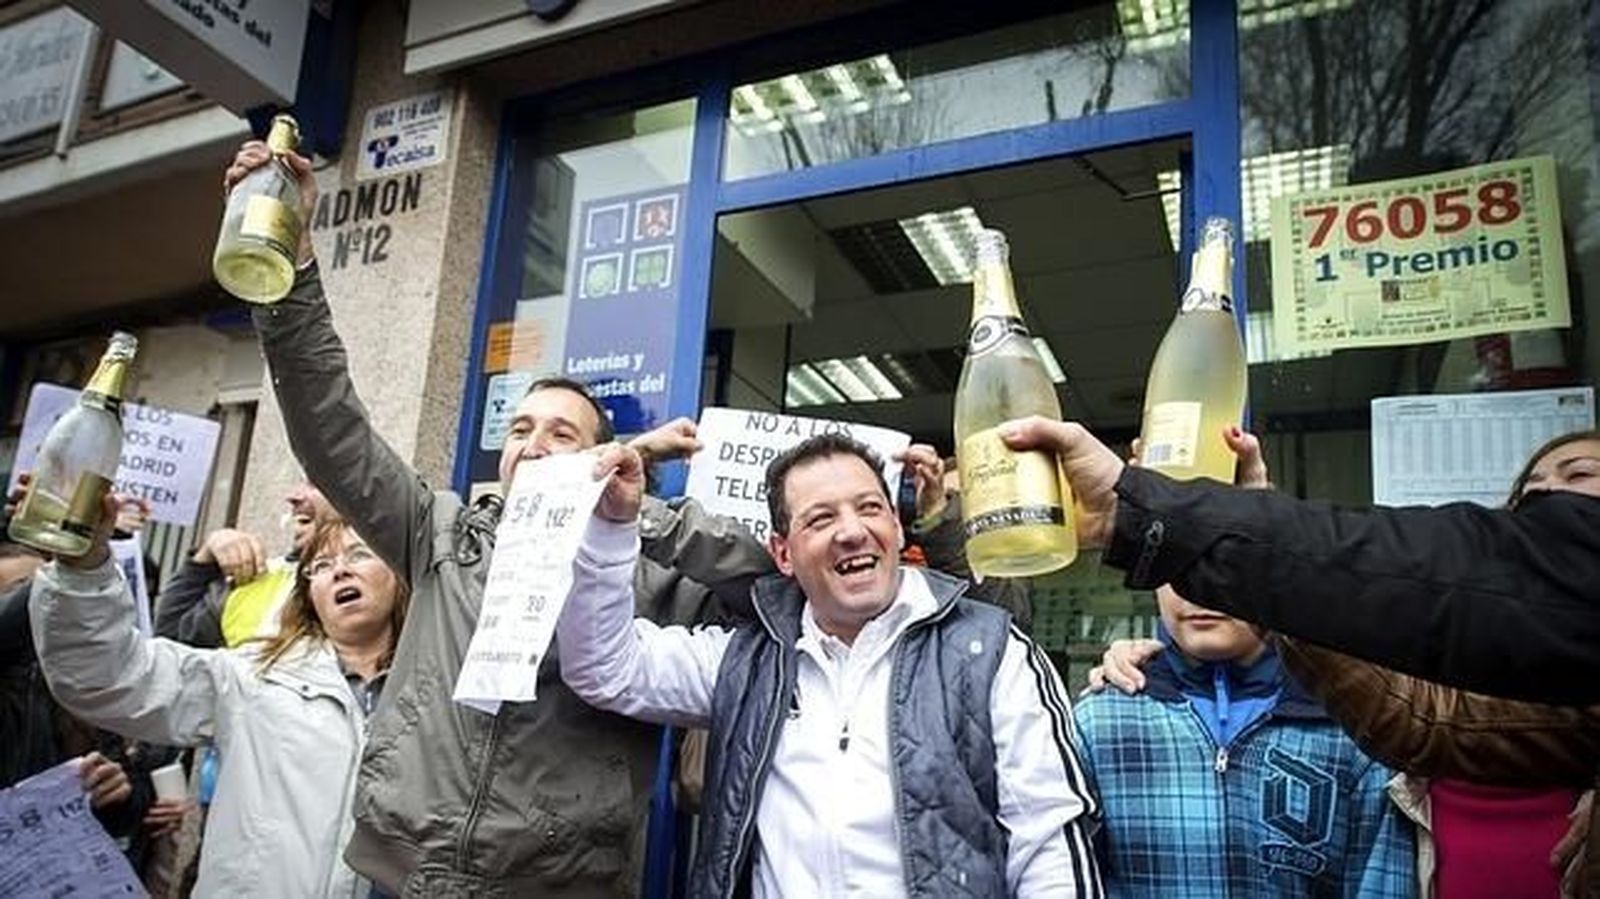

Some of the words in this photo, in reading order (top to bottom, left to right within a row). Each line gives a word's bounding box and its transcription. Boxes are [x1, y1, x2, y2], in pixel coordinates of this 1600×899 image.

[245, 18, 272, 48] del
[313, 173, 422, 230] ADMON
[1303, 180, 1522, 249] 76058
[1366, 236, 1519, 278] Premio
[633, 354, 645, 371] y
[640, 373, 665, 393] del
[745, 414, 779, 433] NO
[785, 419, 800, 436] A
[157, 435, 184, 453] EN
[119, 454, 177, 477] ADRID
